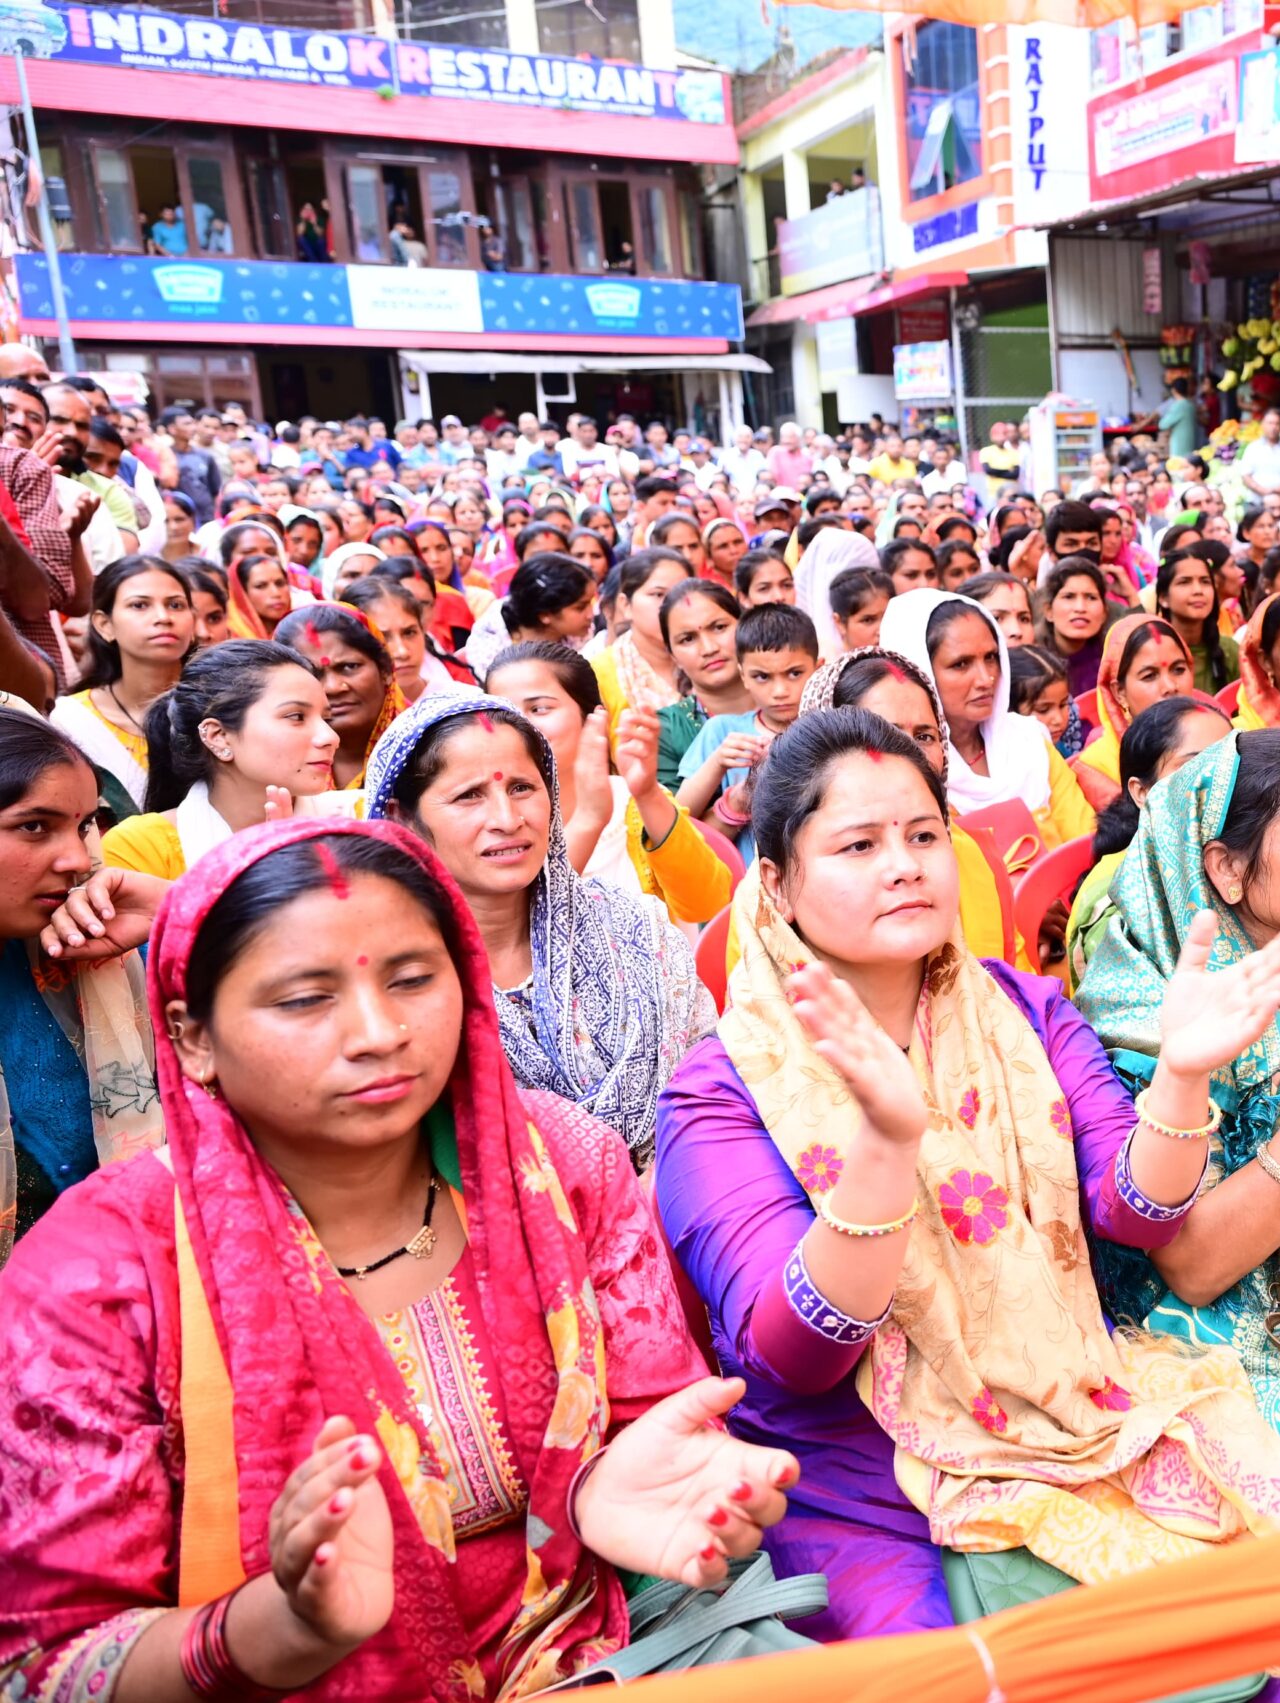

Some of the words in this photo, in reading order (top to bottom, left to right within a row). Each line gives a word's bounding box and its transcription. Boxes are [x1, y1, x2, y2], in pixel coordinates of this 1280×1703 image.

[69, 8, 390, 79] INDRALOK
[397, 45, 677, 108] RESTAURANT
[1025, 38, 1047, 191] RAJPUT
